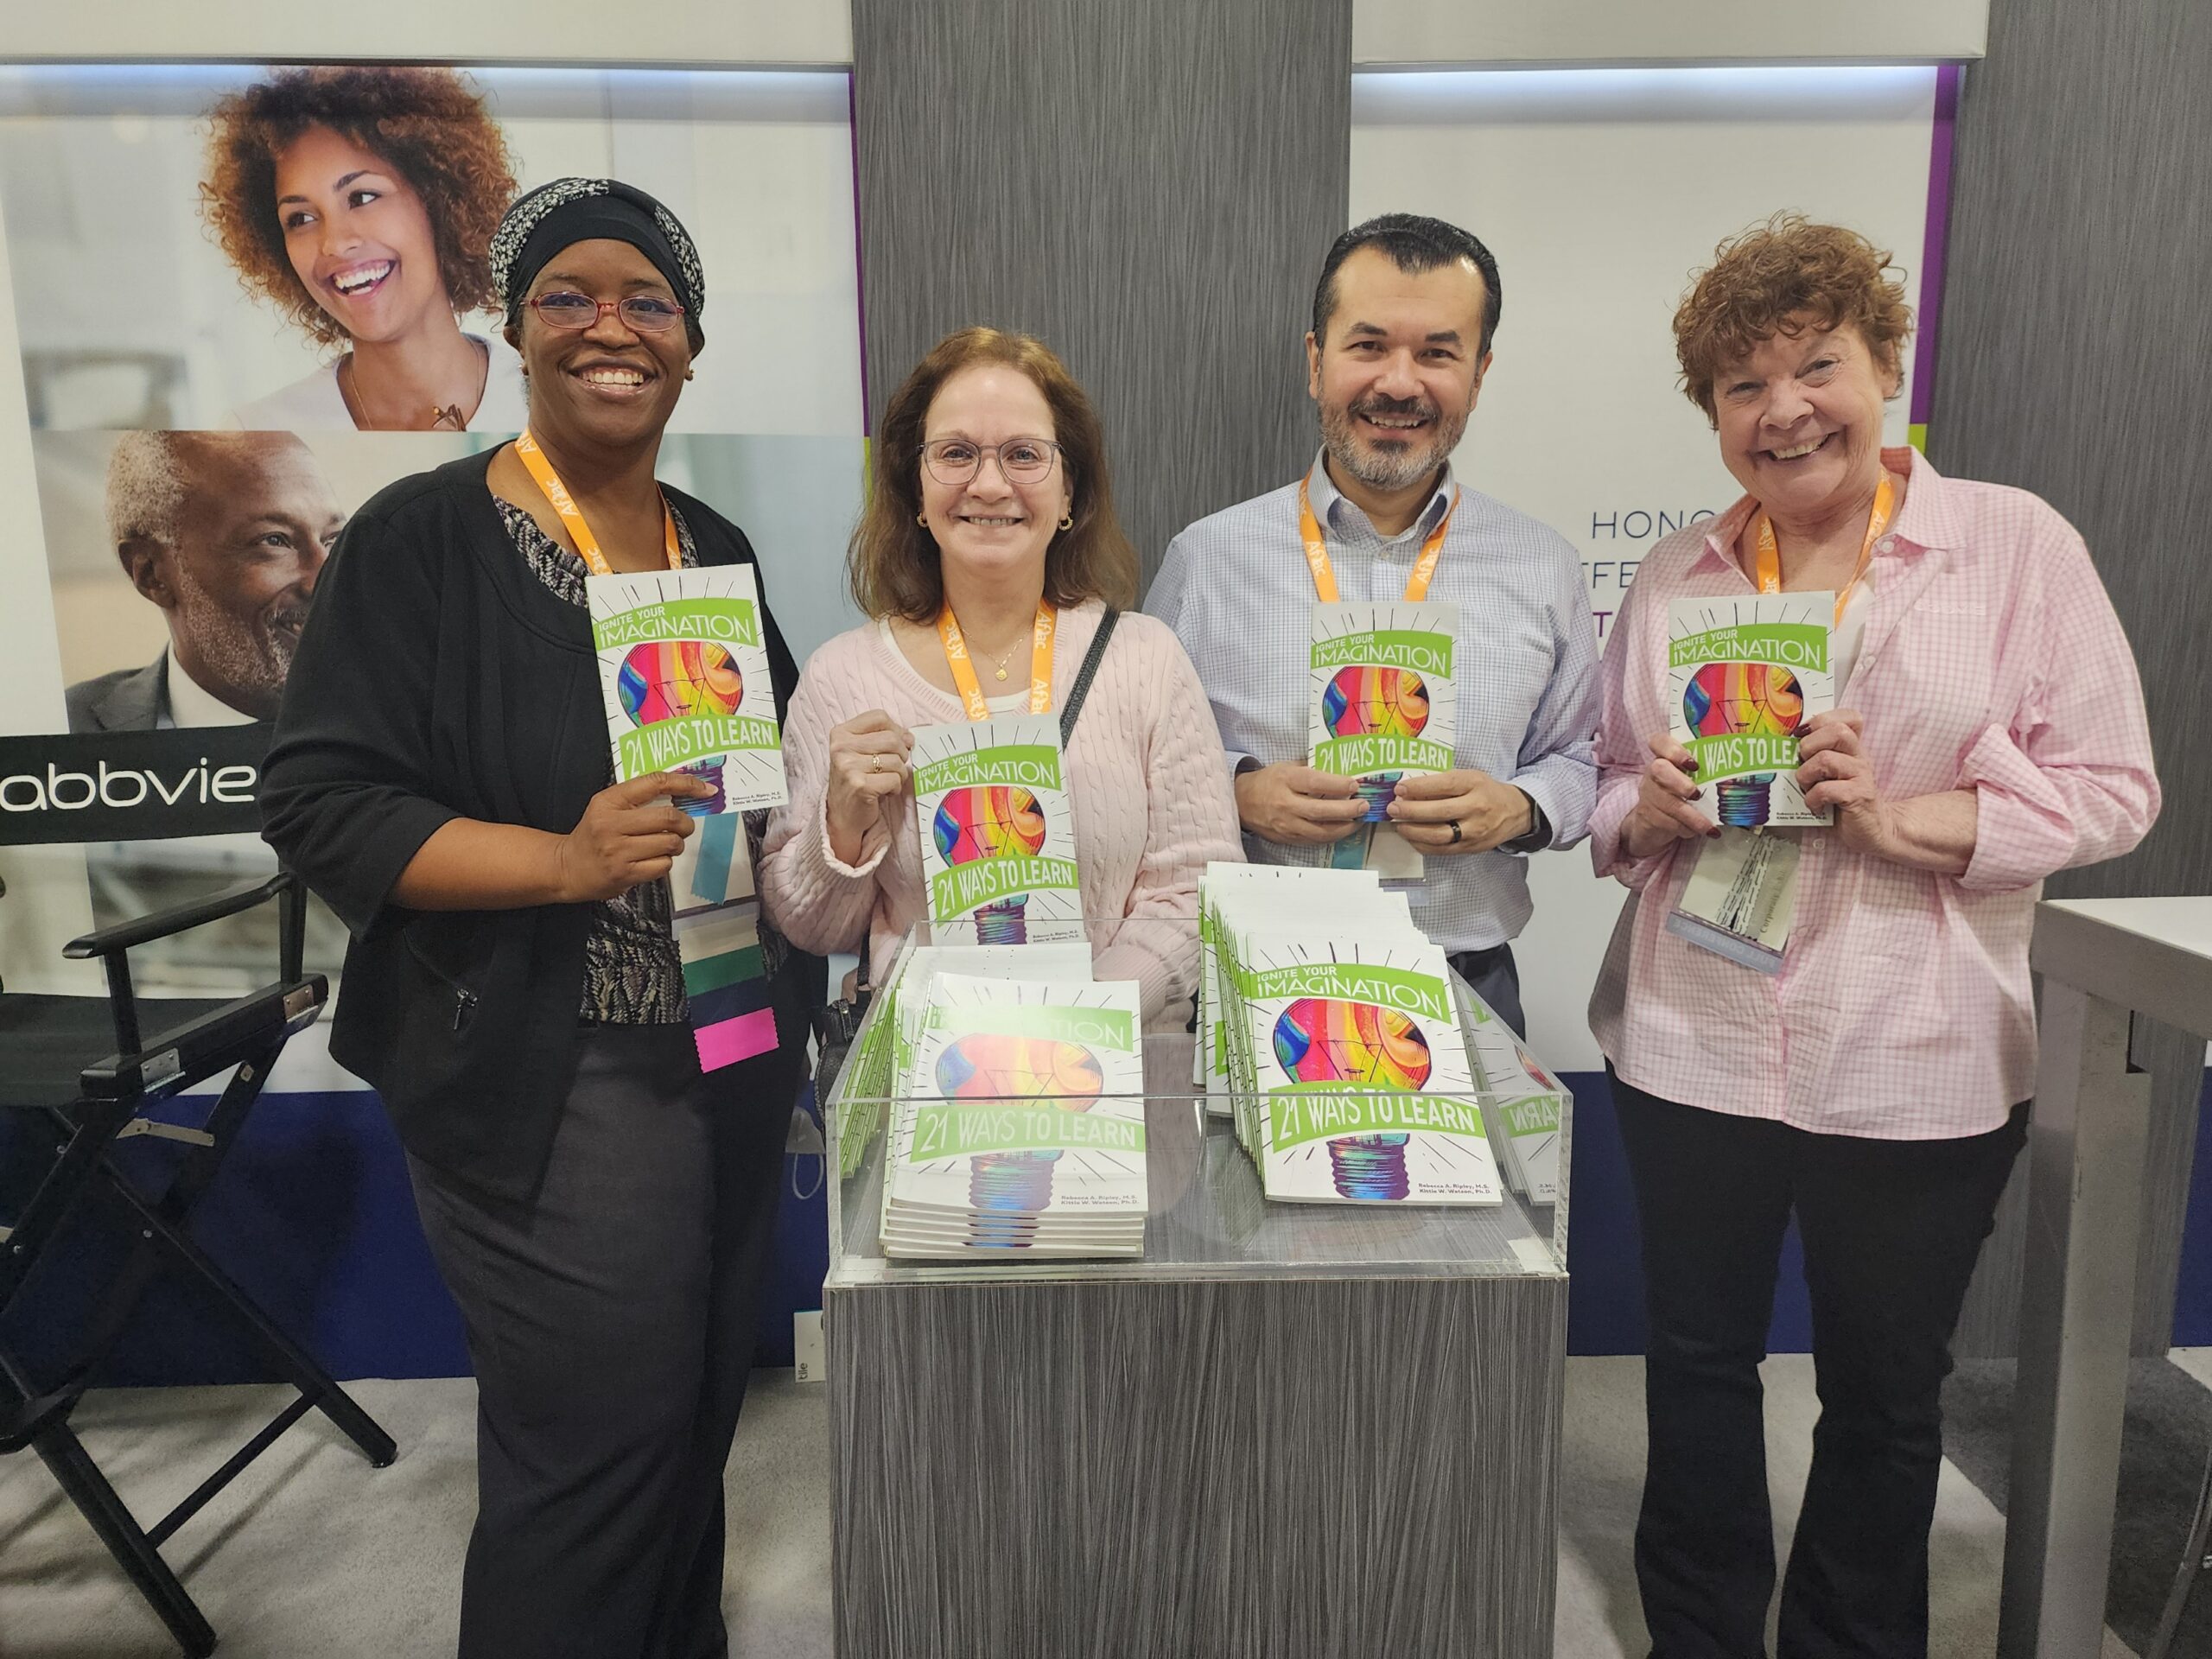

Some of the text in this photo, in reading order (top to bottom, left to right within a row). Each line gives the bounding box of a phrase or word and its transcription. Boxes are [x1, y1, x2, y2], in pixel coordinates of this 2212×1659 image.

[546, 478, 579, 516] Aflac
[1306, 541, 1326, 577] Aflac
[1415, 547, 1440, 584] Aflac
[1581, 562, 1641, 588] FE
[599, 606, 665, 632] IGNITE YOUR
[600, 614, 752, 648] IMAGINATION
[1035, 611, 1052, 650] Aflac
[946, 622, 967, 659] Aflac
[1315, 644, 1446, 674] IMAGINATION
[1316, 634, 1375, 653] IGNITE YOUR
[1674, 629, 1738, 652] IGNITE YOUR
[1674, 639, 1821, 669] IMAGINATION
[626, 719, 774, 777] 21 WAYS TO LEARN
[918, 753, 978, 779] IGNITE YOUR
[1339, 737, 1375, 774] WAYS
[1378, 738, 1396, 766] TO
[1400, 739, 1448, 770] LEARN
[1704, 738, 1744, 777] WAYS
[1746, 738, 1768, 766] TO
[1772, 738, 1800, 765] LEA
[0, 757, 257, 812] abbvie
[919, 760, 1056, 793] IMAGINATION
[938, 860, 1073, 918] 21 WAYS TO LEARN
[1257, 965, 1337, 982] IGNITE YOUR
[1258, 976, 1445, 1020] IMAGINATION
[919, 1110, 1136, 1153] 21 WAYS TO LEARN
[1277, 1086, 1477, 1141] 21 WAYS TO LEARN
